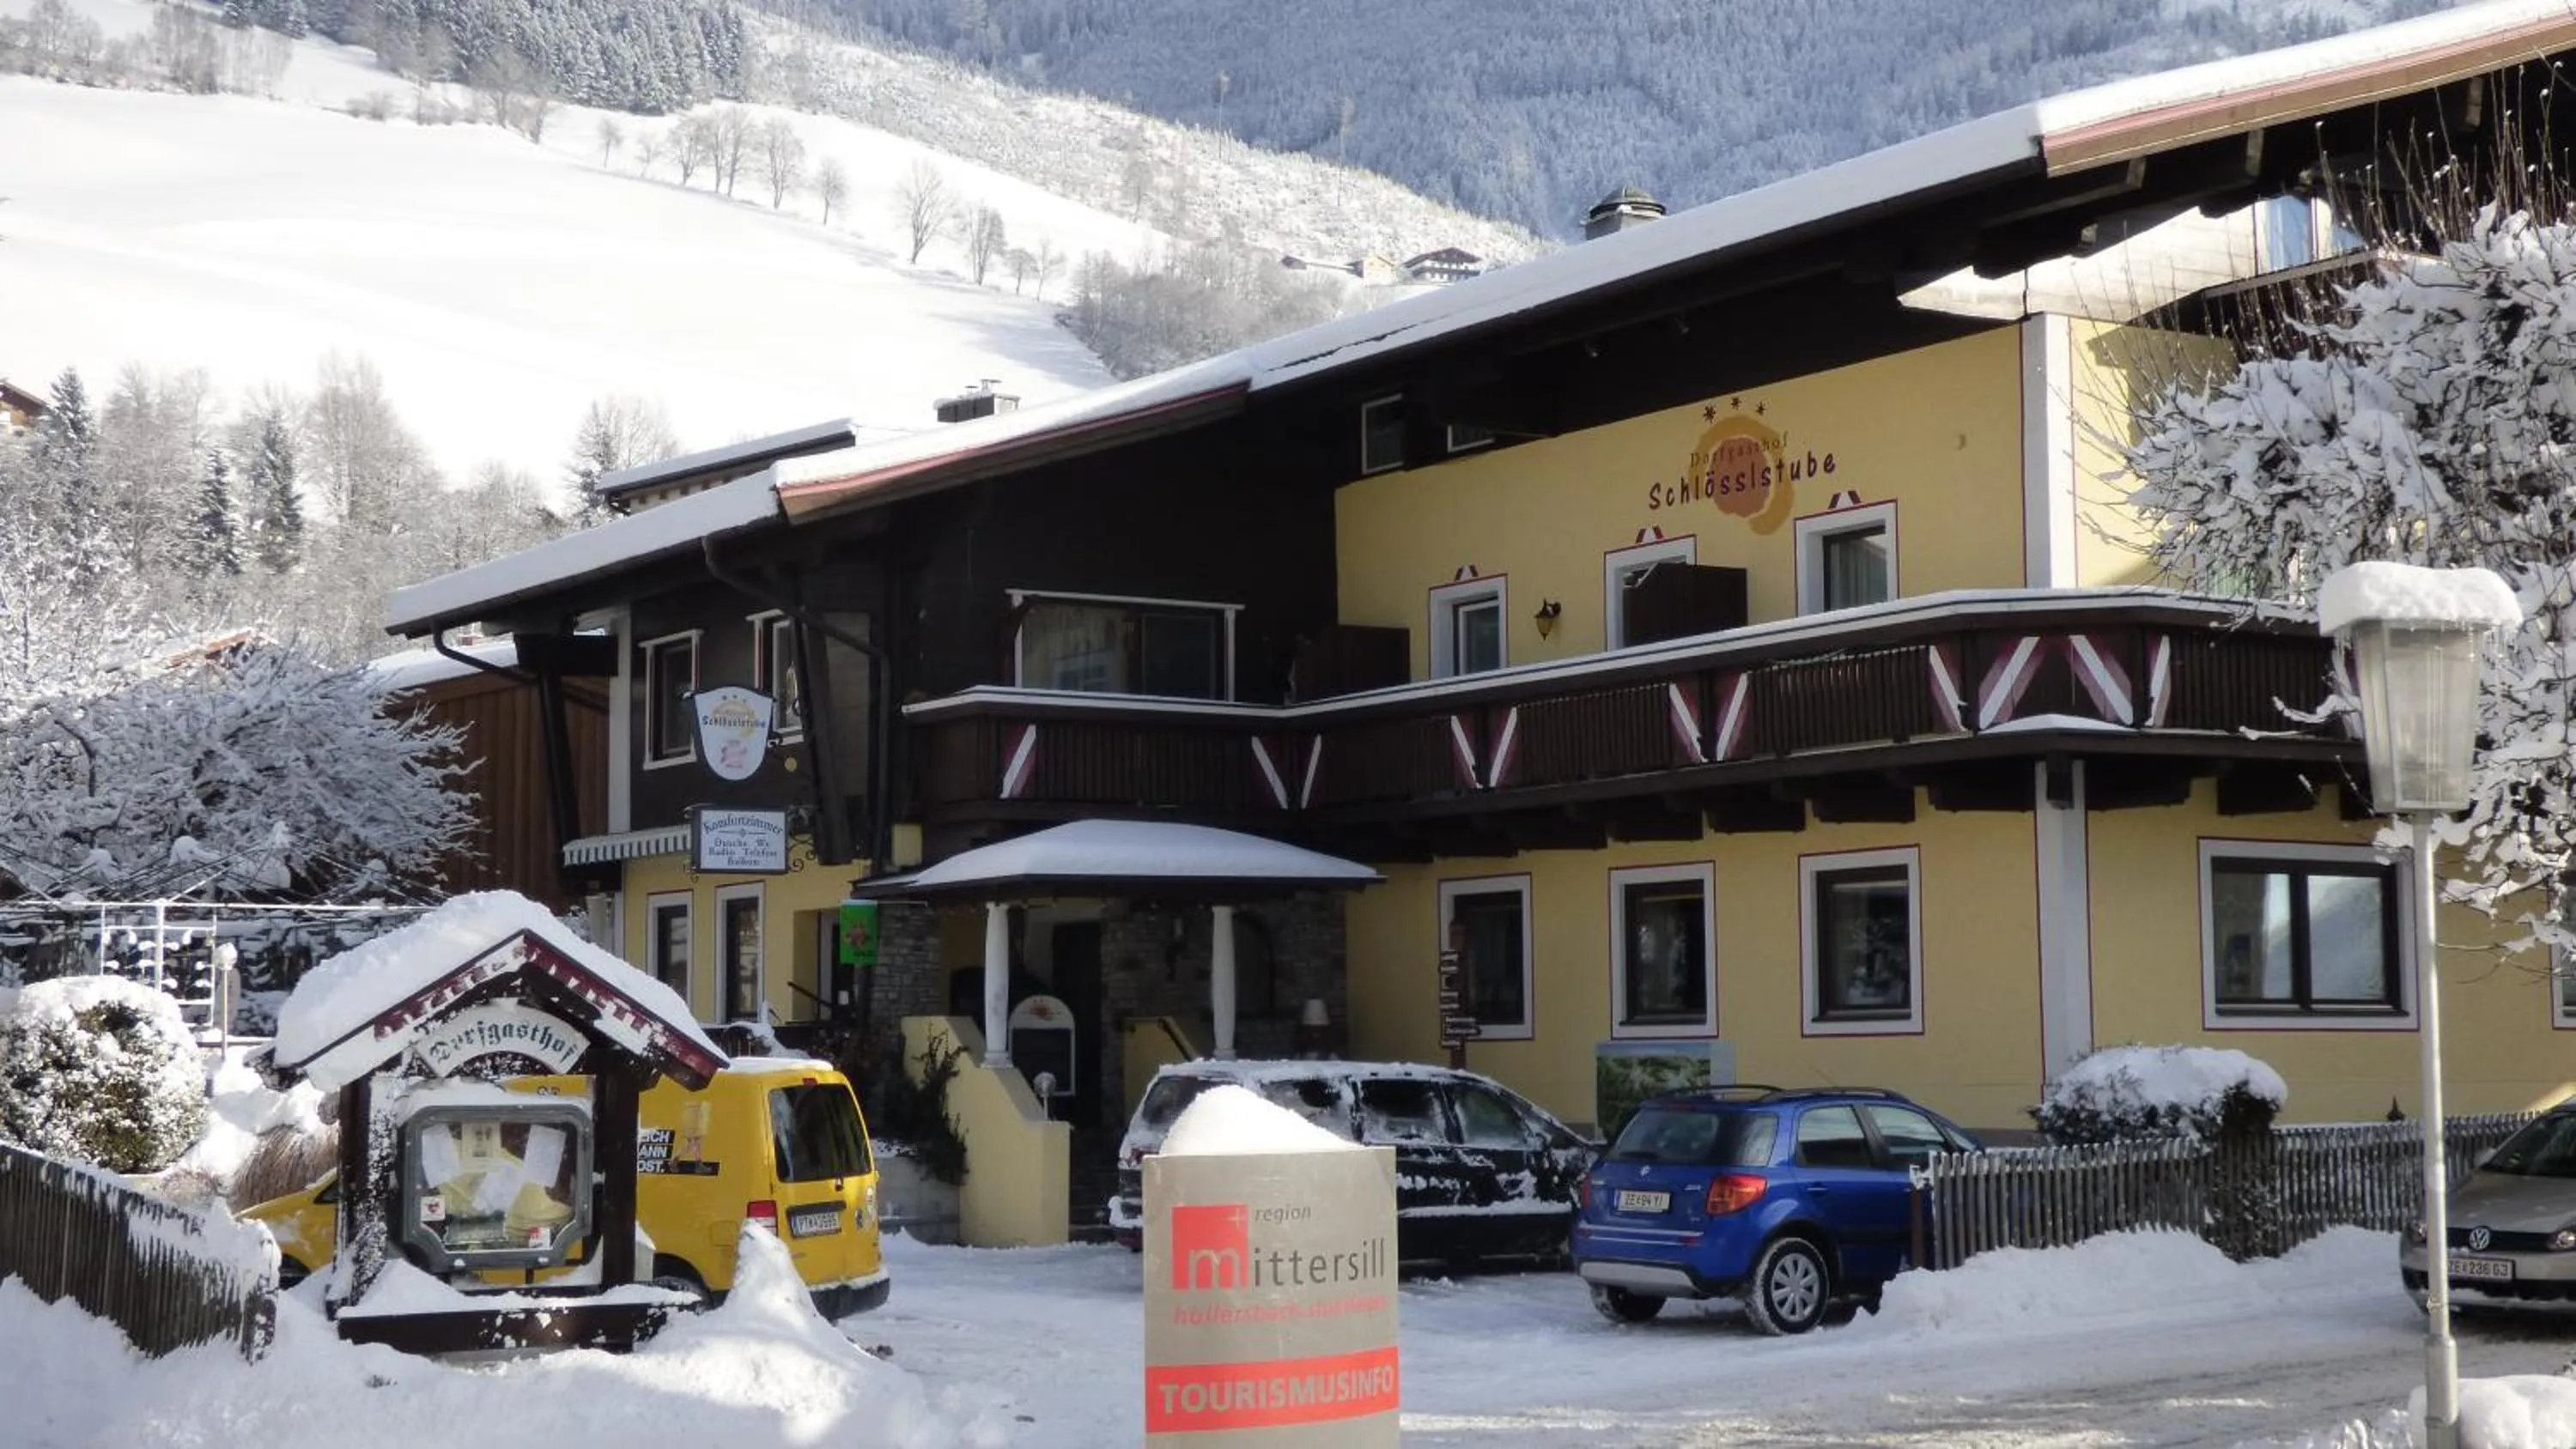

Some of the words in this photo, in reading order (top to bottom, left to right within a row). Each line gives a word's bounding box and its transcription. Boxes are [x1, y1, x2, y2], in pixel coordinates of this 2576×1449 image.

[1648, 451, 1836, 510] Schlösslstube
[429, 1020, 579, 1064] Dorfgasthof
[638, 1144, 667, 1158] ANN
[1255, 1203, 1312, 1223] region
[1188, 1237, 1386, 1291] mittersill
[1159, 1365, 1394, 1415] TOURISMUSINFO
